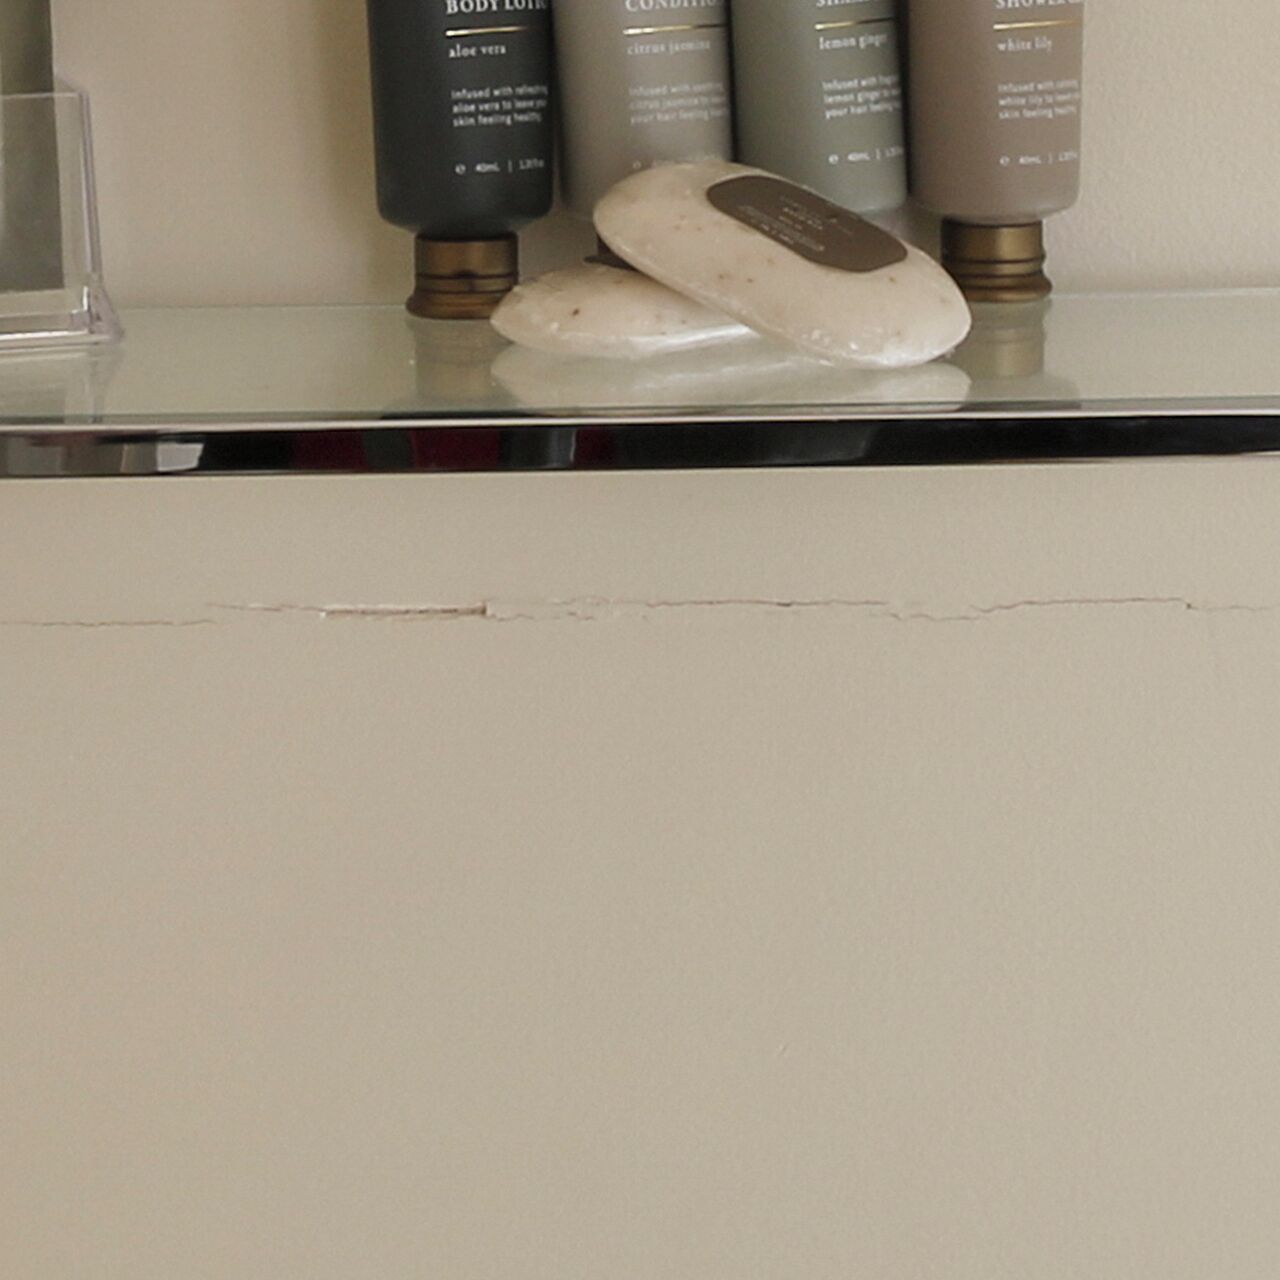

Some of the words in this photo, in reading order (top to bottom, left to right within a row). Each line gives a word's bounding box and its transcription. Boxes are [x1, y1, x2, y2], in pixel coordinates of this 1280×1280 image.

[448, 43, 478, 59] aloe
[480, 44, 507, 57] vera
[627, 41, 666, 56] citrus
[819, 36, 857, 51] lemon
[997, 37, 1033, 52] white
[1034, 35, 1053, 53] lily
